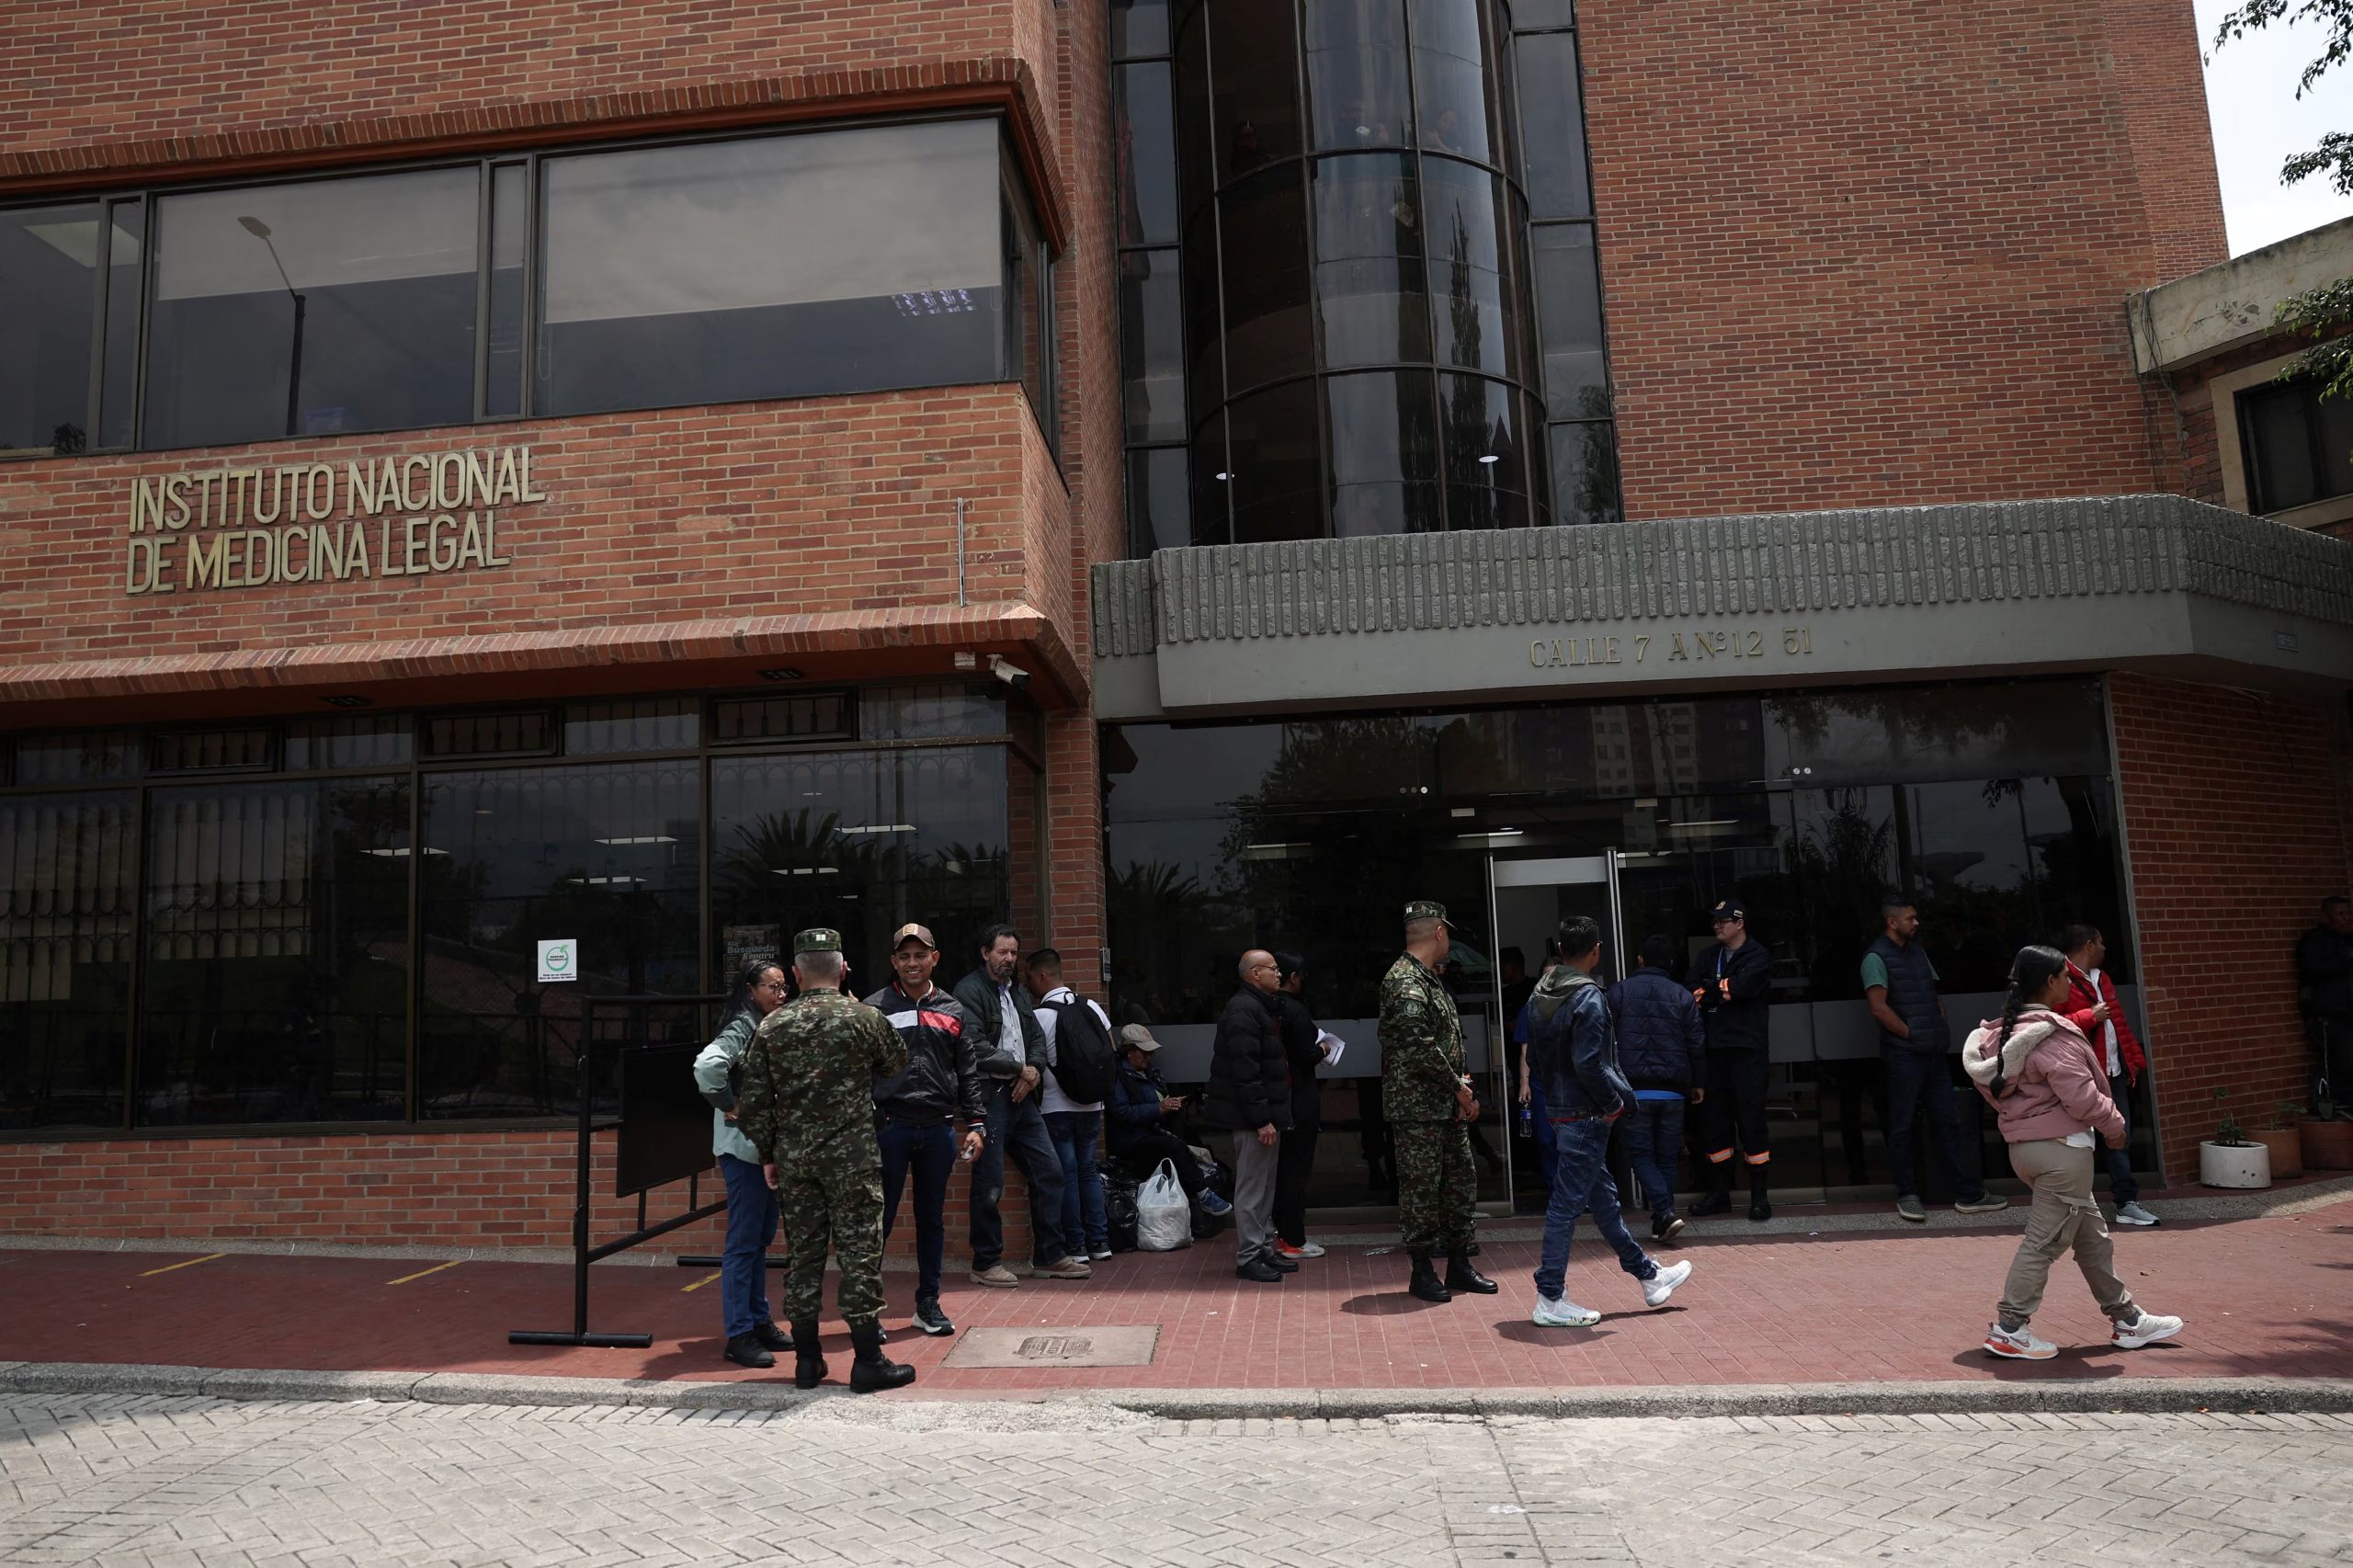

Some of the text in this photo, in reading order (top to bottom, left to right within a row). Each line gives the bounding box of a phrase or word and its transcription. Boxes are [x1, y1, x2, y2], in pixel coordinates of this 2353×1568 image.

[129, 446, 546, 533] INSTITUTO NACIONAL
[125, 510, 512, 594] DE MEDICINA LEGAL
[1529, 637, 1621, 667] CALLE
[1635, 634, 1651, 663] 7
[1668, 632, 1688, 661] A
[1783, 625, 1813, 654] 51
